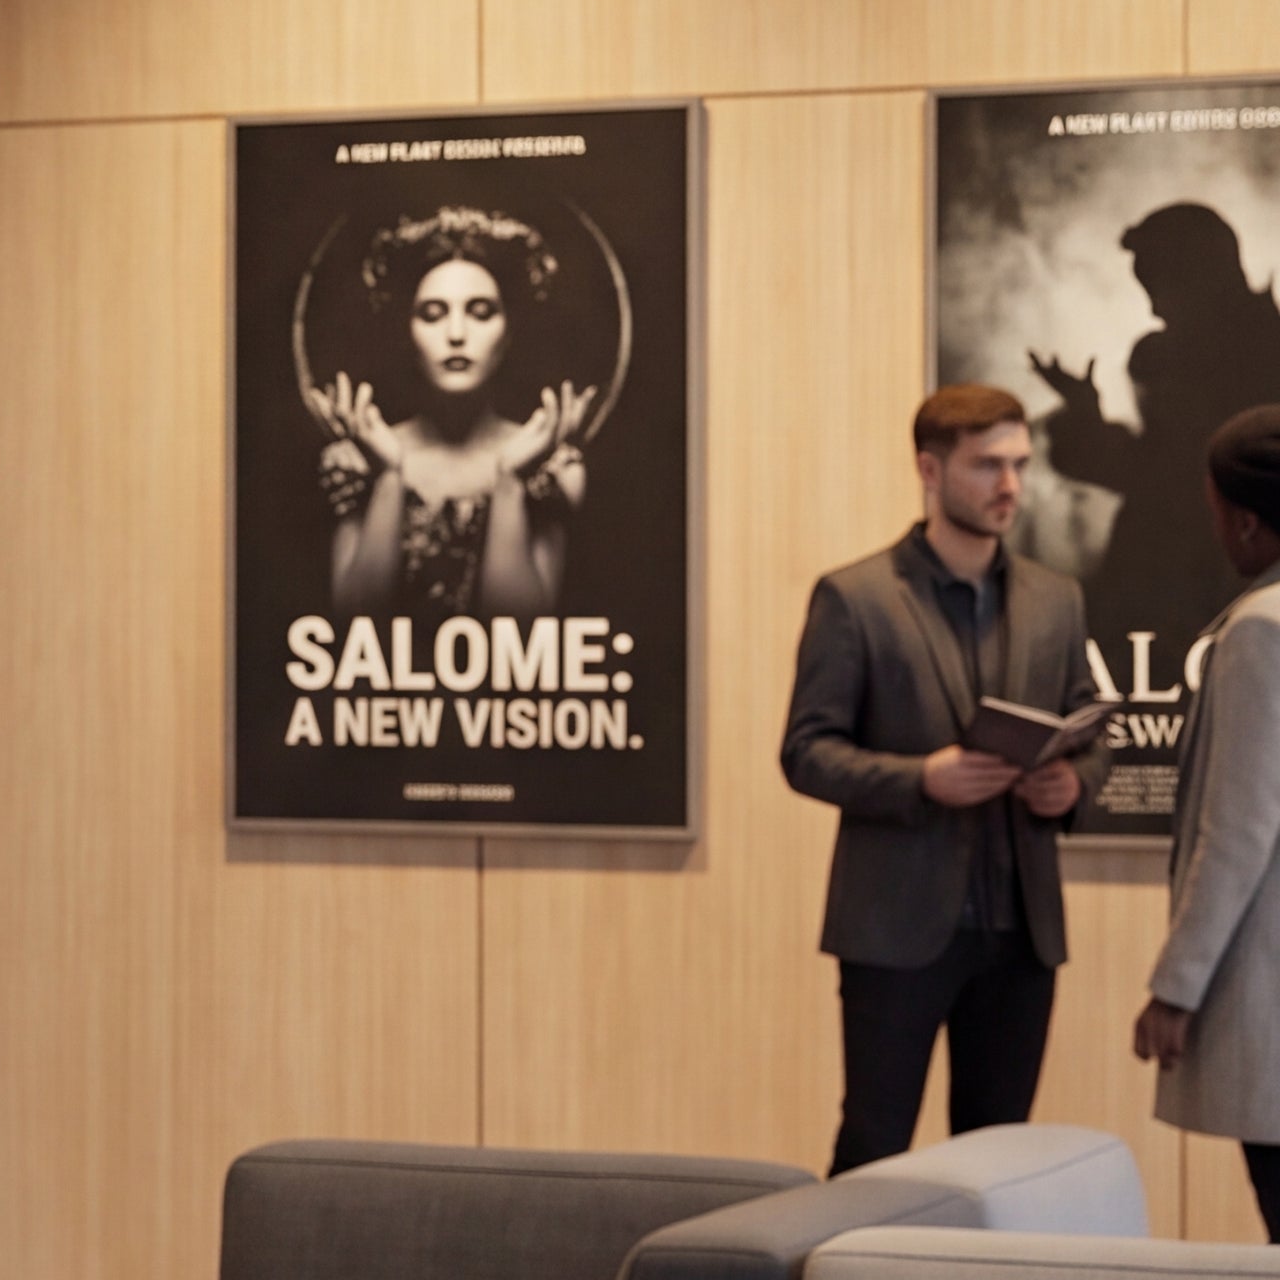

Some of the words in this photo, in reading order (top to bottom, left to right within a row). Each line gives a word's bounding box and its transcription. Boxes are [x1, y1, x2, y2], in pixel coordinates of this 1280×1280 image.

[285, 615, 635, 693] SALOME:
[285, 696, 322, 747] A
[334, 696, 444, 748] NEW
[455, 697, 645, 750] VISION.
